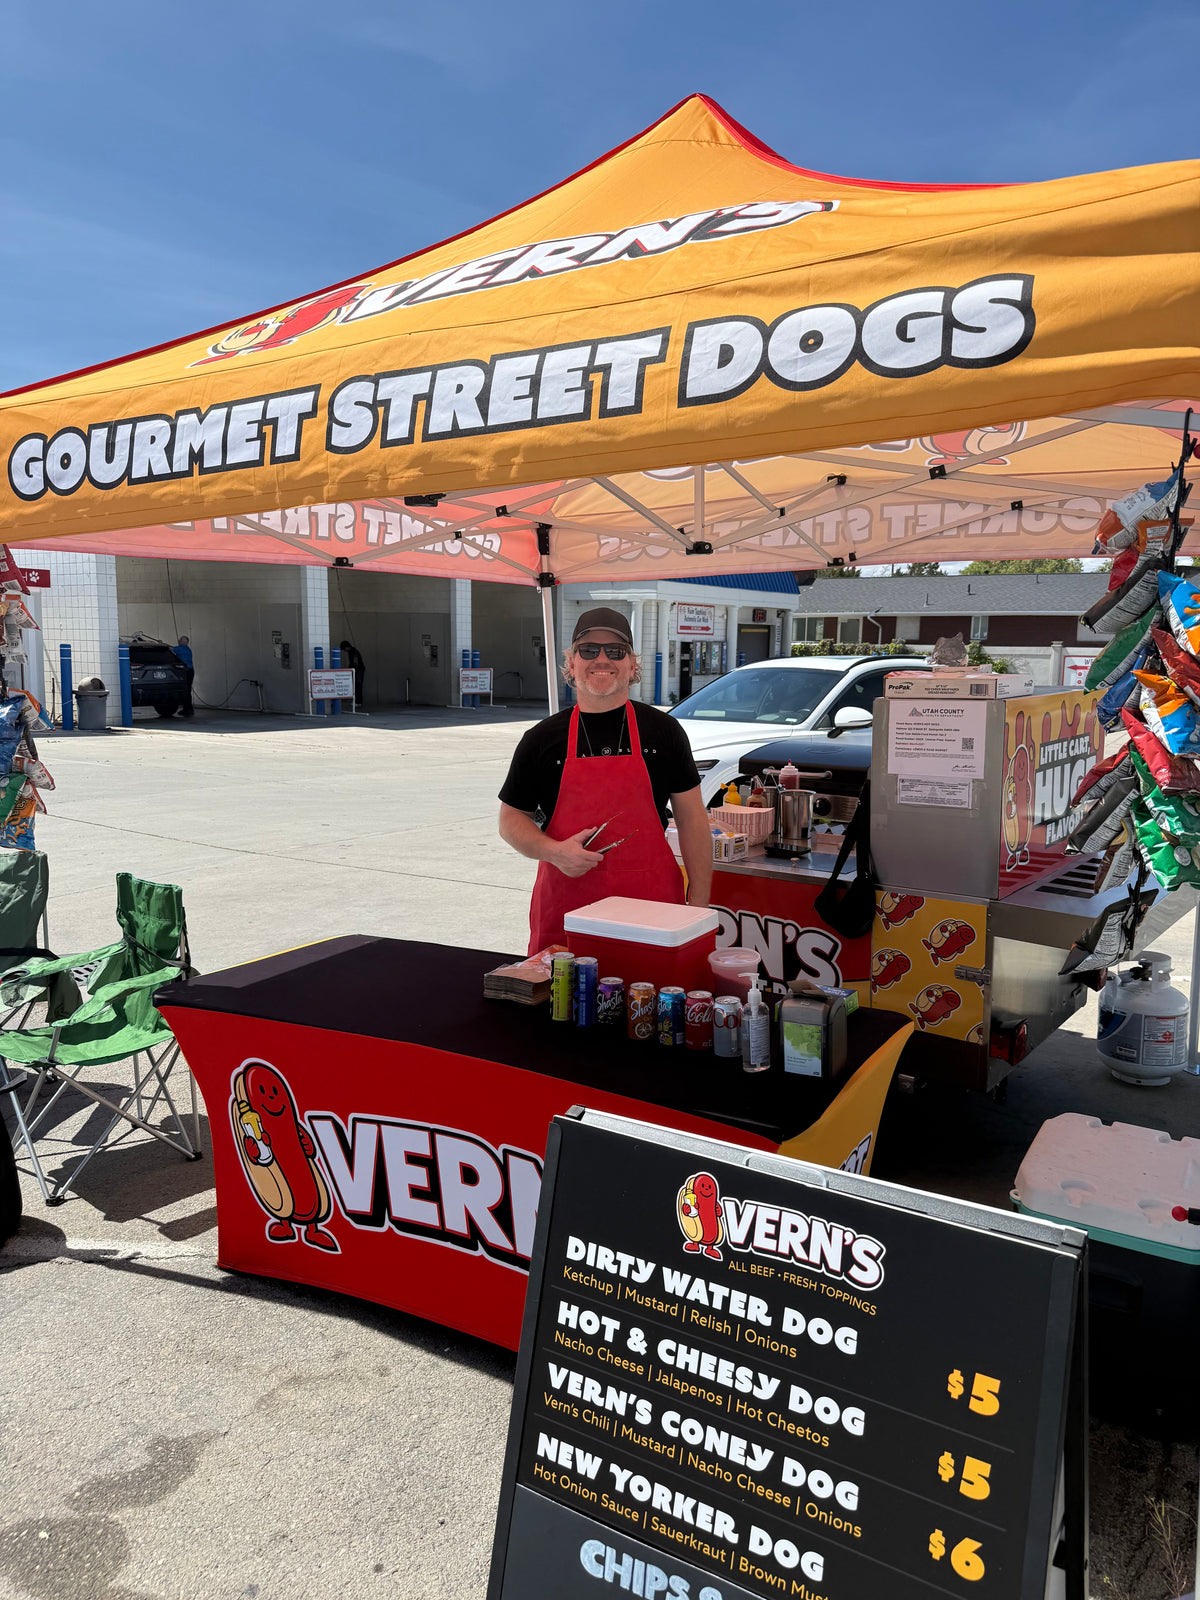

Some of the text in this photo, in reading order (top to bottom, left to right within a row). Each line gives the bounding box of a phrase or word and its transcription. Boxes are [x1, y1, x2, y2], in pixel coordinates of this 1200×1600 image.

[340, 200, 840, 325] VERN'S
[8, 273, 1036, 500] GOURMET STREET DOGS
[1034, 755, 1097, 826] HUG
[1040, 741, 1068, 765] LITTLE
[597, 991, 623, 1014] Shasta
[630, 995, 656, 1020] Shast
[721, 1198, 886, 1291] VERN'S
[728, 1260, 877, 1316] ALL BEEF FRESH TOPPINGS
[562, 1265, 797, 1358] Ketchup Mustard Relish Onions
[566, 1235, 858, 1355] DIRTY WATER DOG
[555, 1331, 830, 1447] Nacho Cheese Jalapenos Hot Cheetos
[557, 1300, 866, 1436] HOT & CHEESY DOG
[947, 1368, 1001, 1416] $5
[543, 1391, 862, 1538] Vern's Chili Mustard Nacho Cheese Onions
[548, 1362, 859, 1511] VERN'S CONEY DOG
[937, 1450, 991, 1501] $5
[534, 1462, 829, 1600] Hot Onion Sauce Sauerkraut Brown Mus
[536, 1432, 825, 1582] NEW YORKER DOG
[580, 1539, 691, 1600] CHIPS
[928, 1528, 985, 1581] $6
